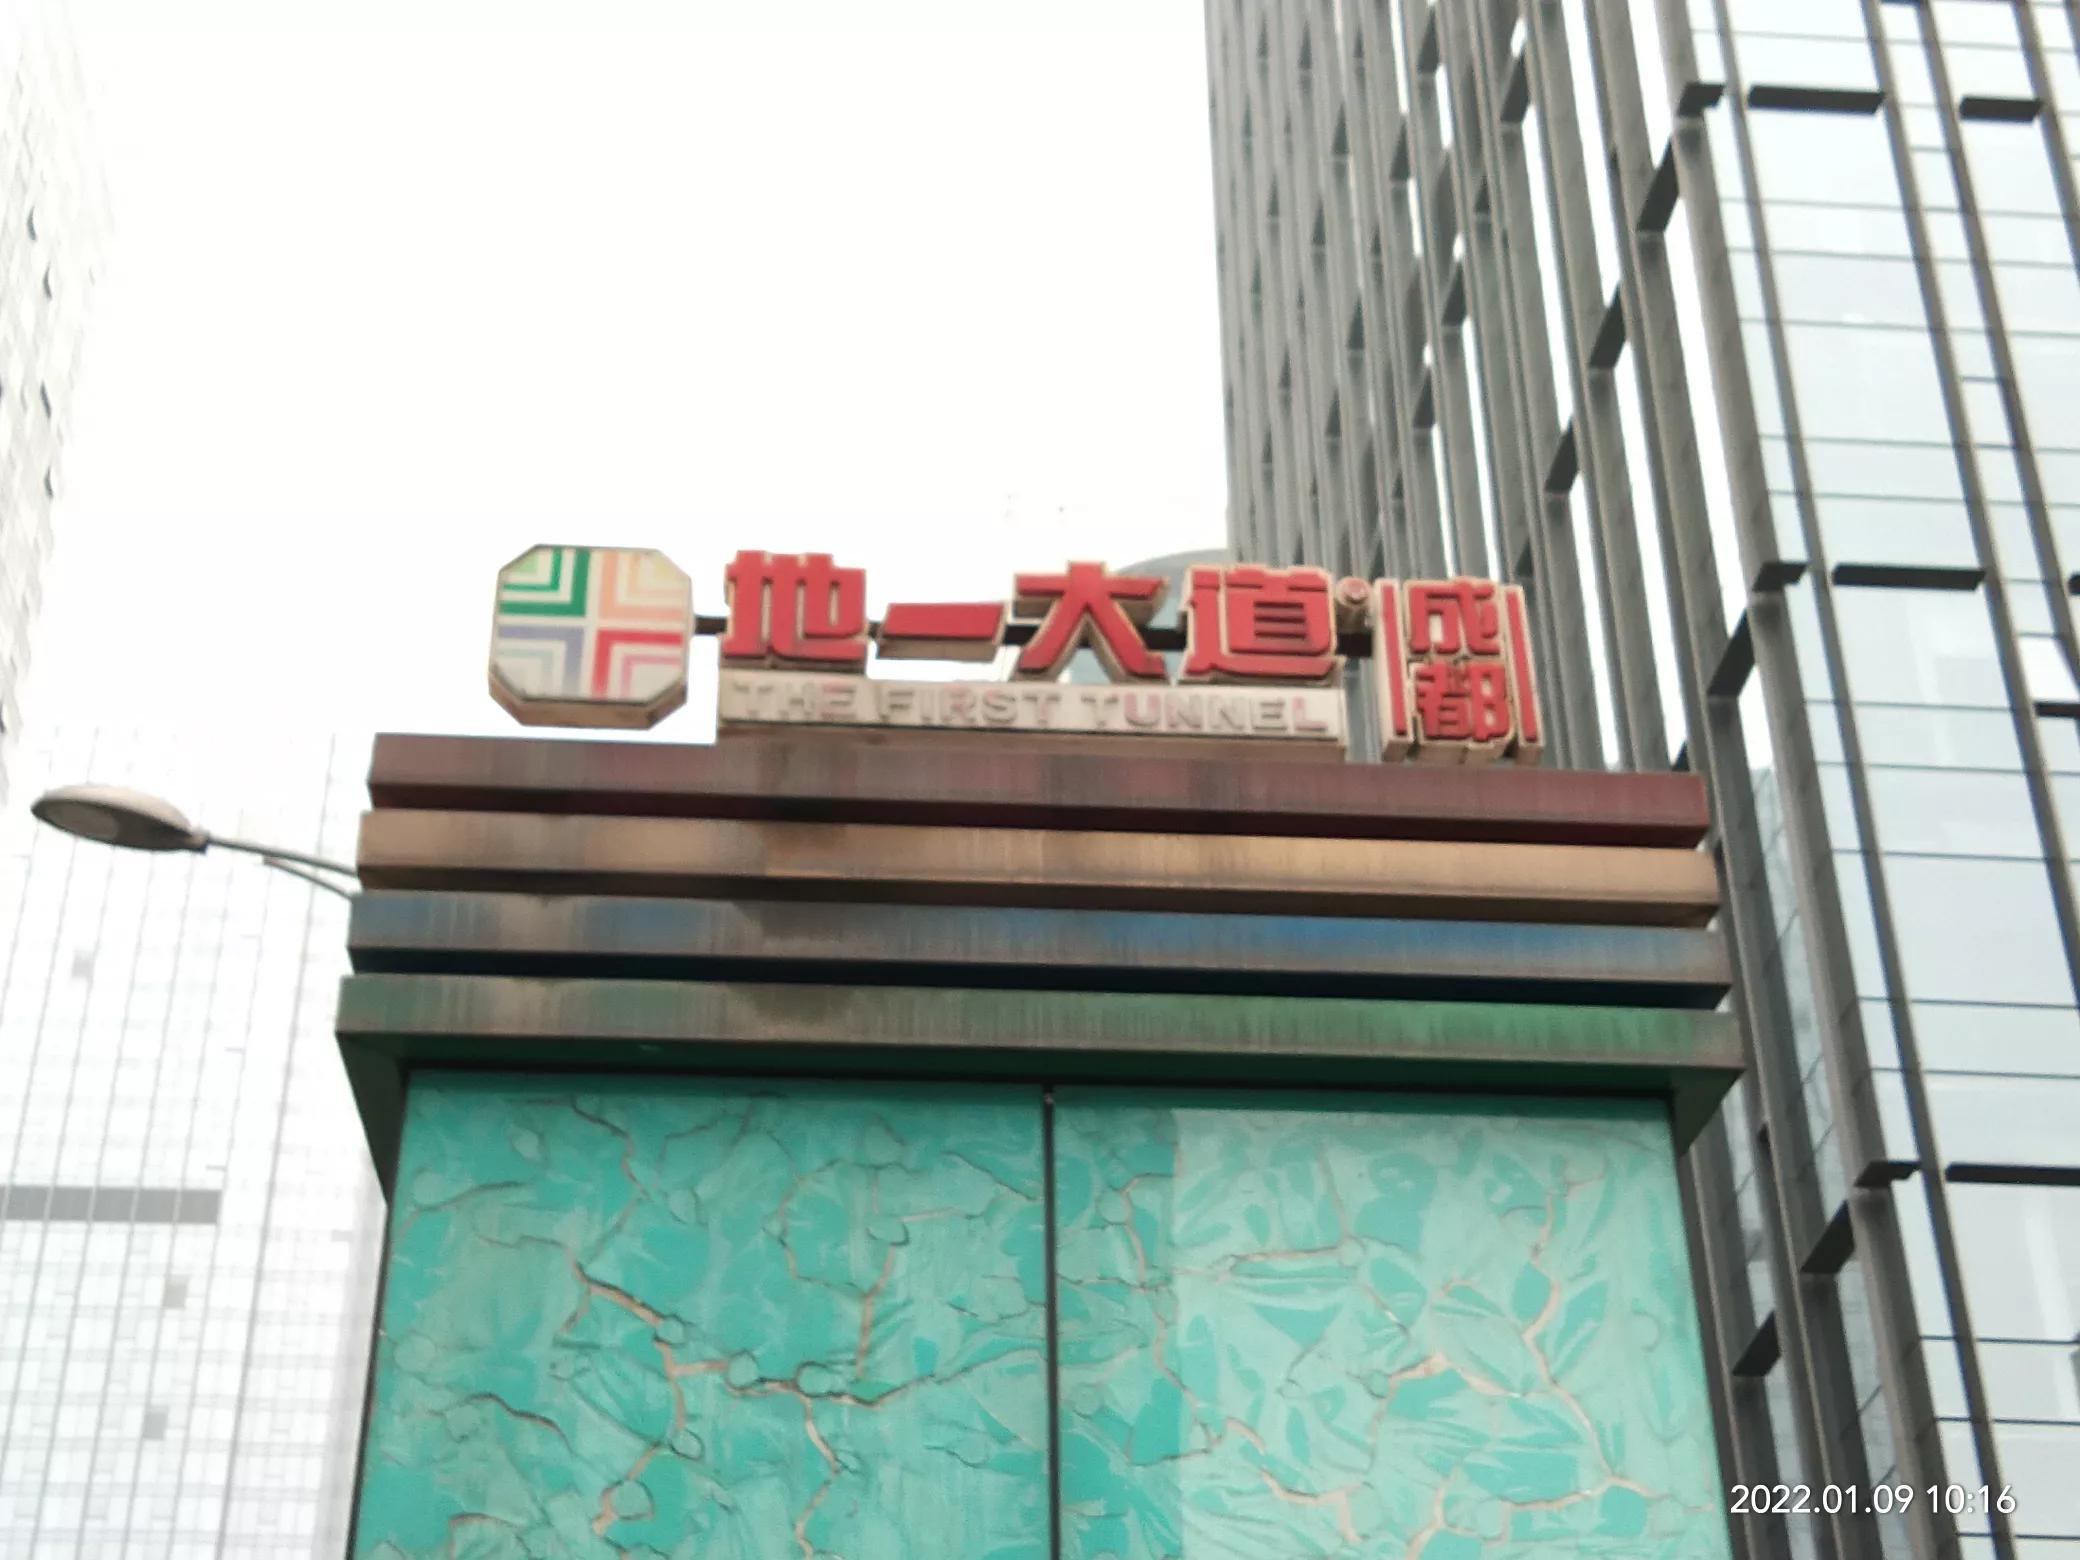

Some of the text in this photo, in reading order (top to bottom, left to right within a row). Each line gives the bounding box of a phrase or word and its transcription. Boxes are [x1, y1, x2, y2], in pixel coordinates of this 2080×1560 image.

[725, 550, 1338, 679] 地一大道
[1408, 578, 1513, 740] 成都
[732, 682, 1328, 733] THE FIRST TUNNEL
